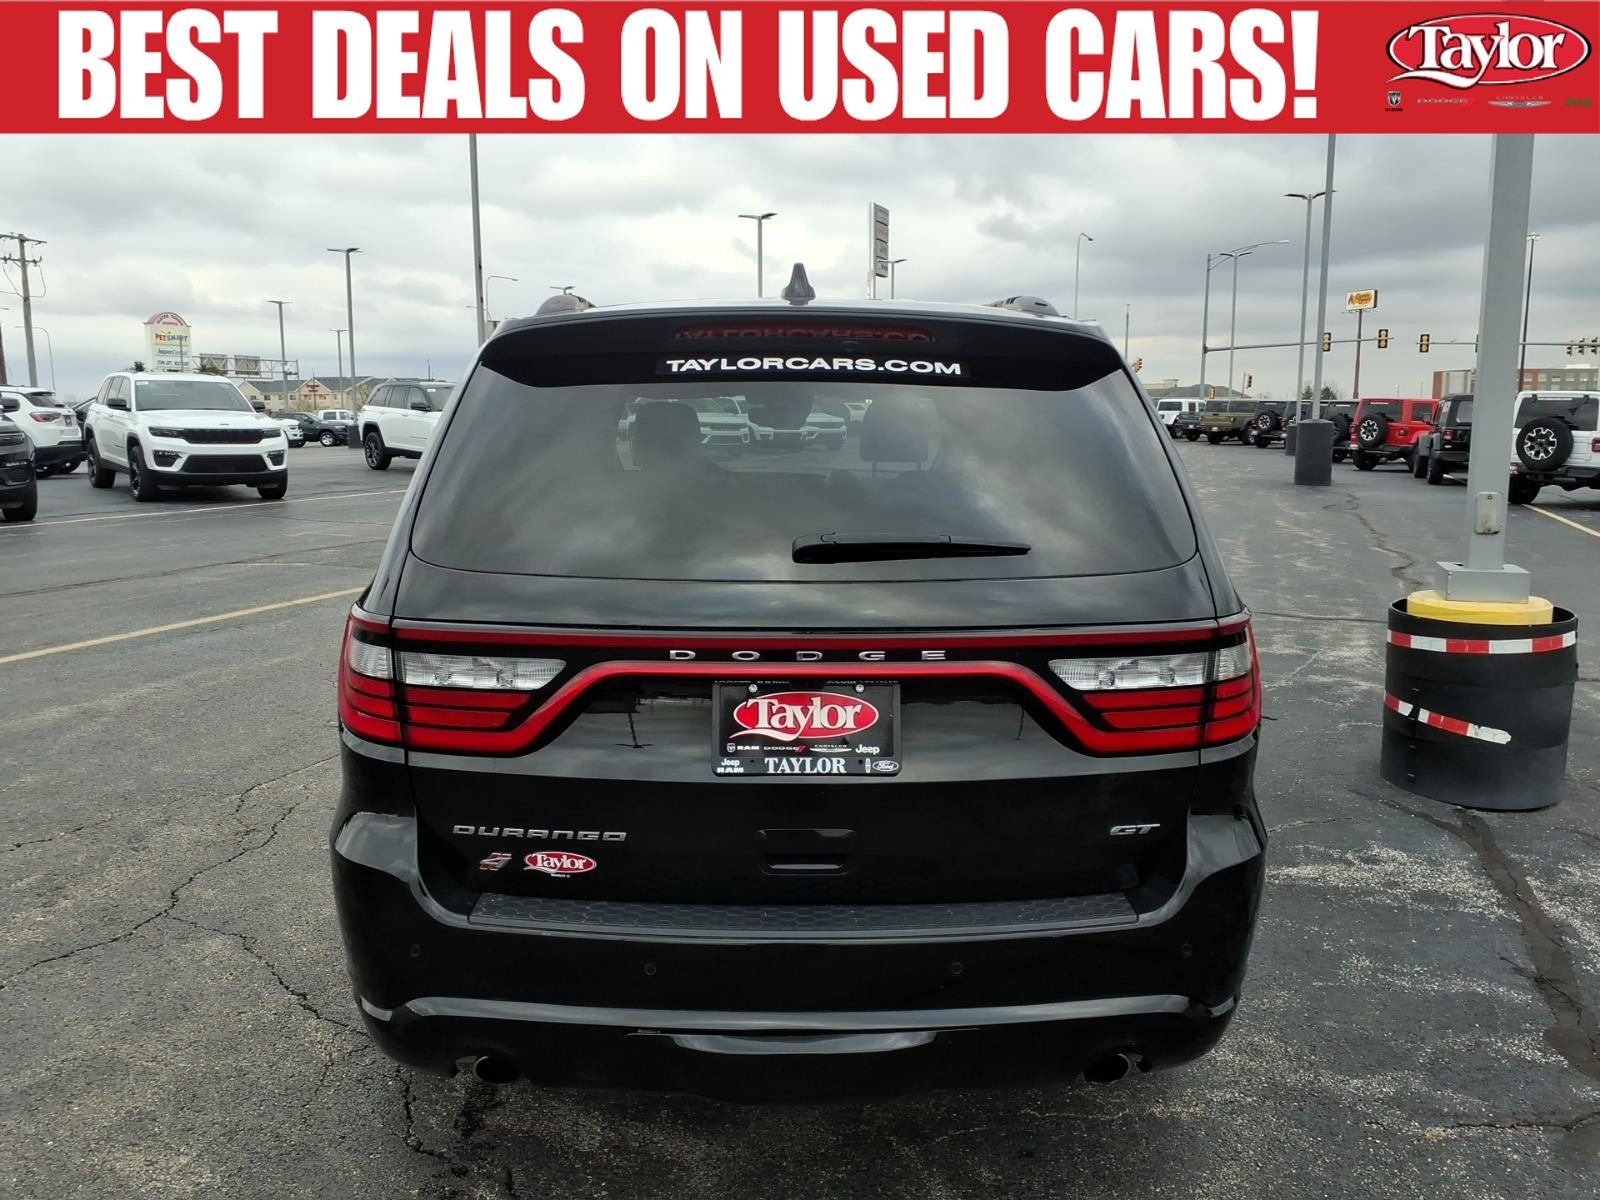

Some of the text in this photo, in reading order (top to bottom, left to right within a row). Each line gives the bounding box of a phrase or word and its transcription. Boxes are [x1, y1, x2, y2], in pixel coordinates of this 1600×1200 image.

[666, 357, 962, 375] TAYLORCARS.COM
[669, 649, 946, 661] DODGE
[730, 696, 862, 742] Taylor
[855, 743, 880, 755] Jeep
[720, 758, 740, 768] Jeep
[764, 757, 847, 774] TAYLOR
[452, 824, 627, 842] DURANGO
[1109, 823, 1161, 836] GT
[524, 853, 588, 874] Taylor
